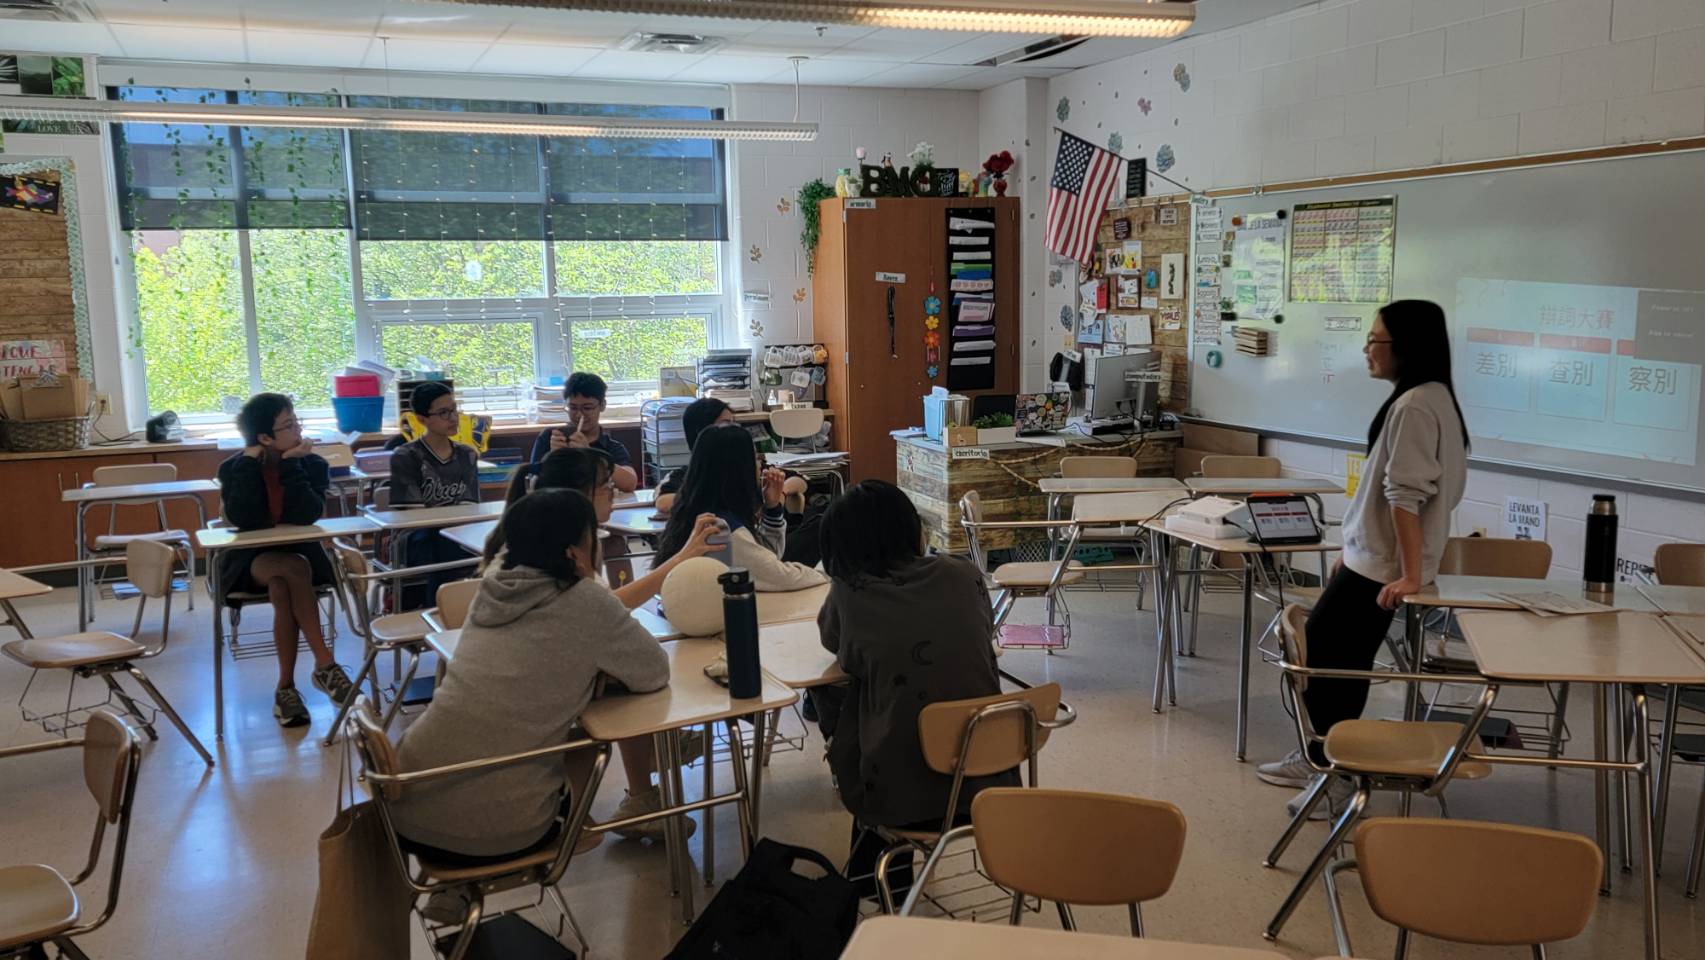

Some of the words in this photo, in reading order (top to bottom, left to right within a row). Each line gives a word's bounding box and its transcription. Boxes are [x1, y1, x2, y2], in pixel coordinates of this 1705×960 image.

[1475, 352, 1517, 379] 差別
[1549, 359, 1594, 387] 查別
[1629, 365, 1677, 396] 察別
[1508, 514, 1517, 524] LA
[1519, 516, 1540, 528] MANO
[1509, 501, 1540, 516] LEVANTA
